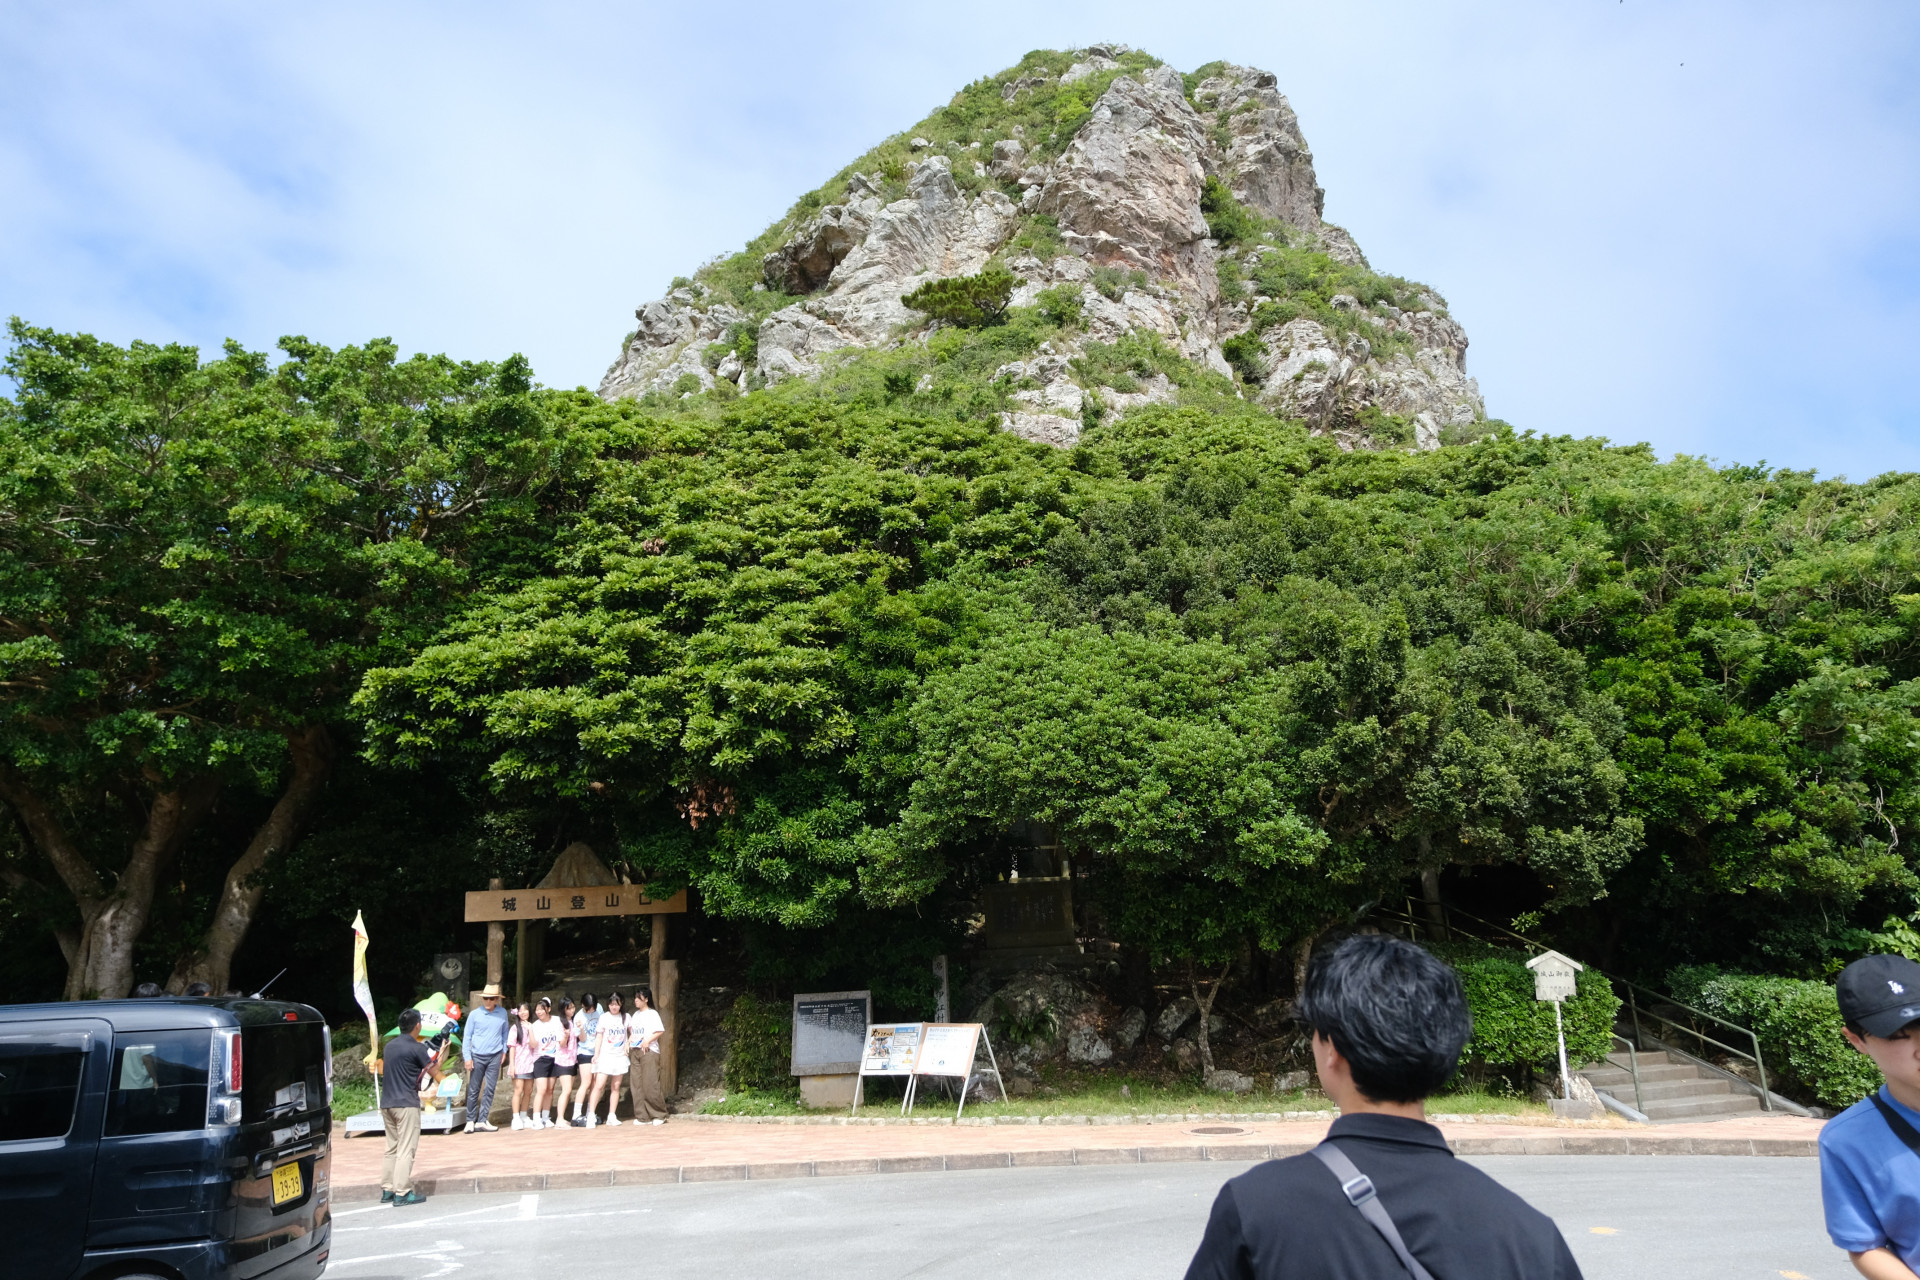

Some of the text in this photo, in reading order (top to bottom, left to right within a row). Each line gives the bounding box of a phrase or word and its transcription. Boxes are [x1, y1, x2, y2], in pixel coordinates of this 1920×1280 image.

[501, 892, 653, 913] 城山登山口
